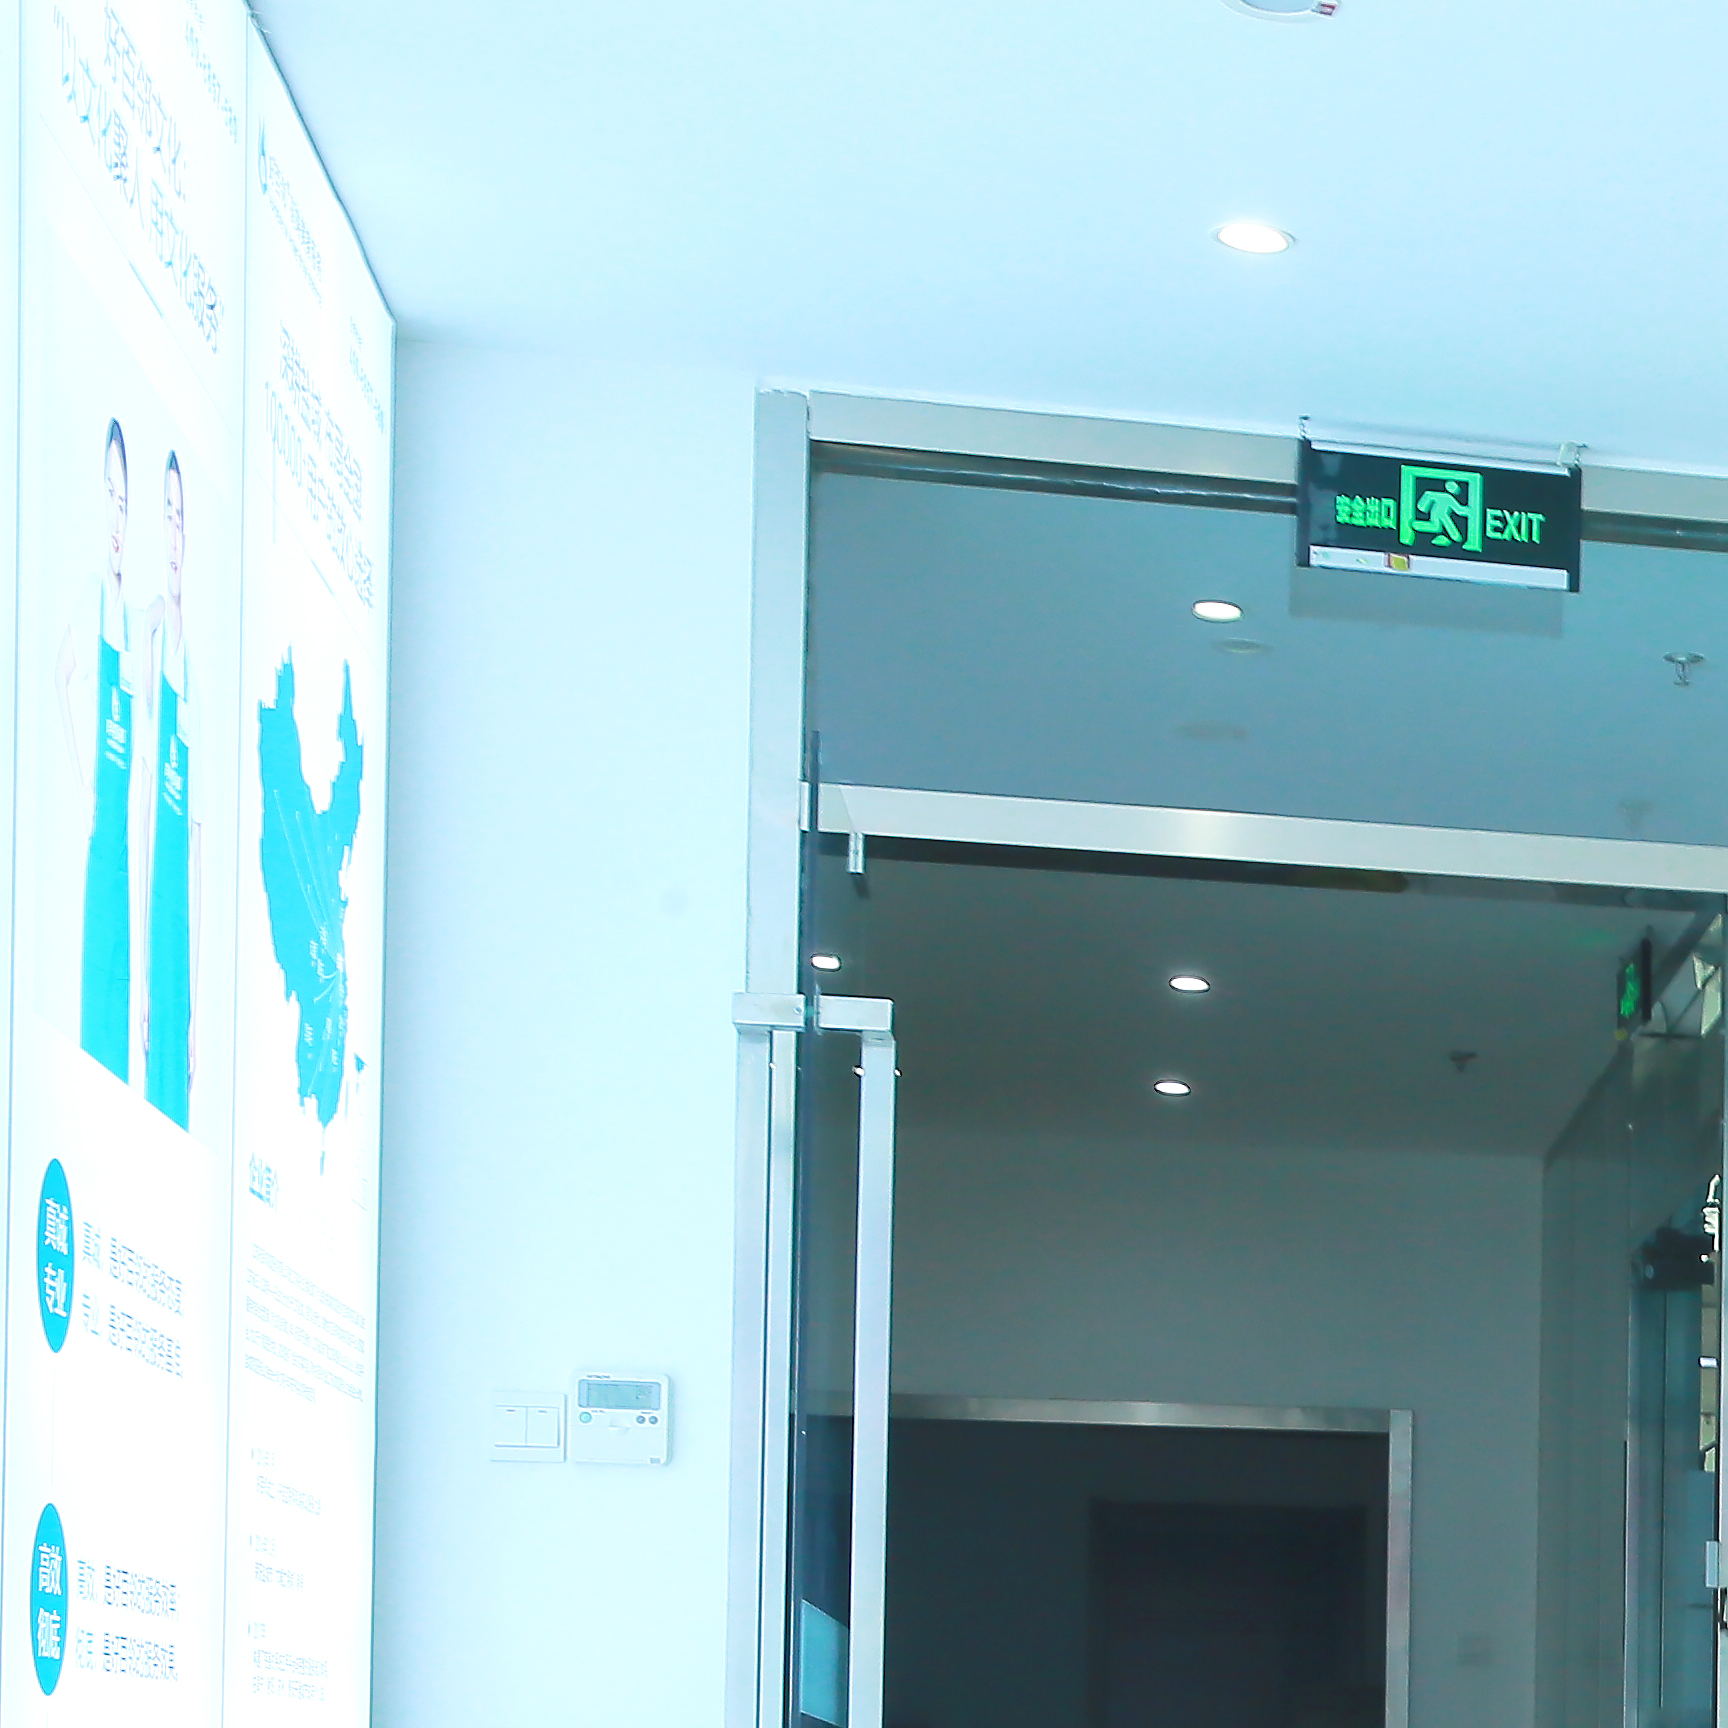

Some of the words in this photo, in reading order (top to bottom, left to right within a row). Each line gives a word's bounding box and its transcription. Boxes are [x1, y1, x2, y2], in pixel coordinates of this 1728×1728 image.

[1335, 494, 1397, 530] 安全出口
[1486, 508, 1546, 544] EXIT
[44, 1196, 69, 1257] 真诚
[43, 1262, 68, 1318] 专业
[38, 1541, 63, 1598] 高效
[36, 1606, 62, 1661] 彻底
